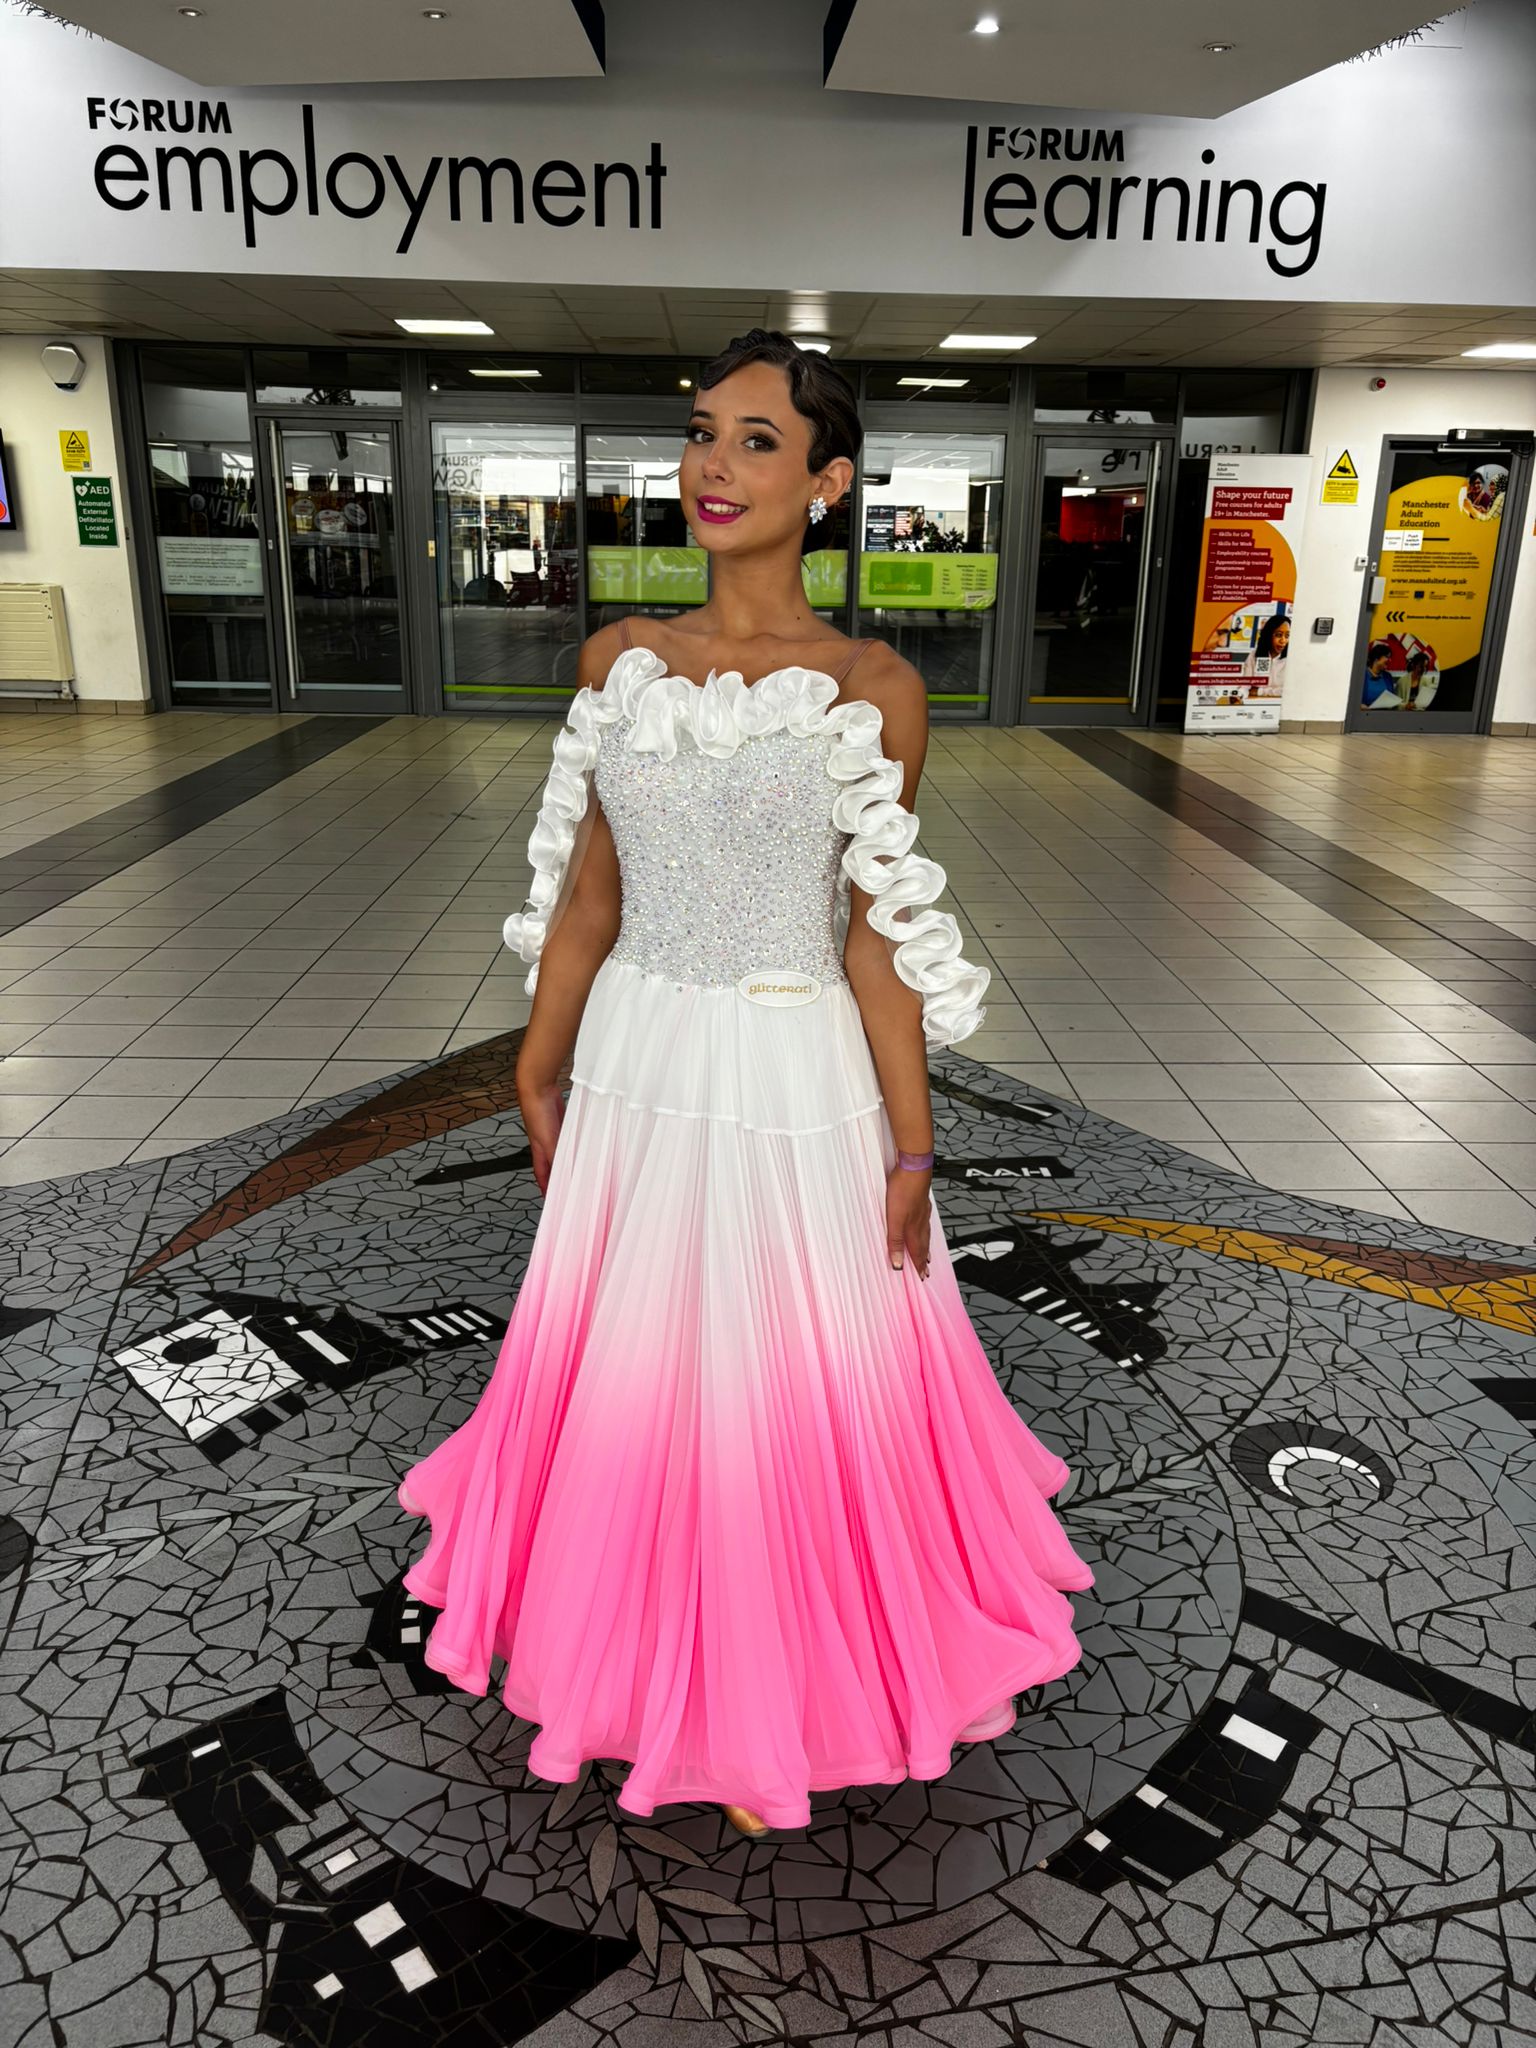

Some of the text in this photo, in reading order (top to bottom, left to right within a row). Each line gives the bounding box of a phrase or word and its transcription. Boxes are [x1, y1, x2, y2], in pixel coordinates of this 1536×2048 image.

[86, 97, 233, 134] FORUM
[987, 127, 1125, 162] FORUM
[94, 104, 668, 254] employment
[962, 125, 1328, 278] learning
[90, 486, 110, 495] AED
[1216, 490, 1290, 501] Shape your future
[1402, 500, 1450, 509] Manchester
[1400, 510, 1424, 518] Adult
[1399, 520, 1440, 528] Education
[748, 983, 812, 995] glitterati
